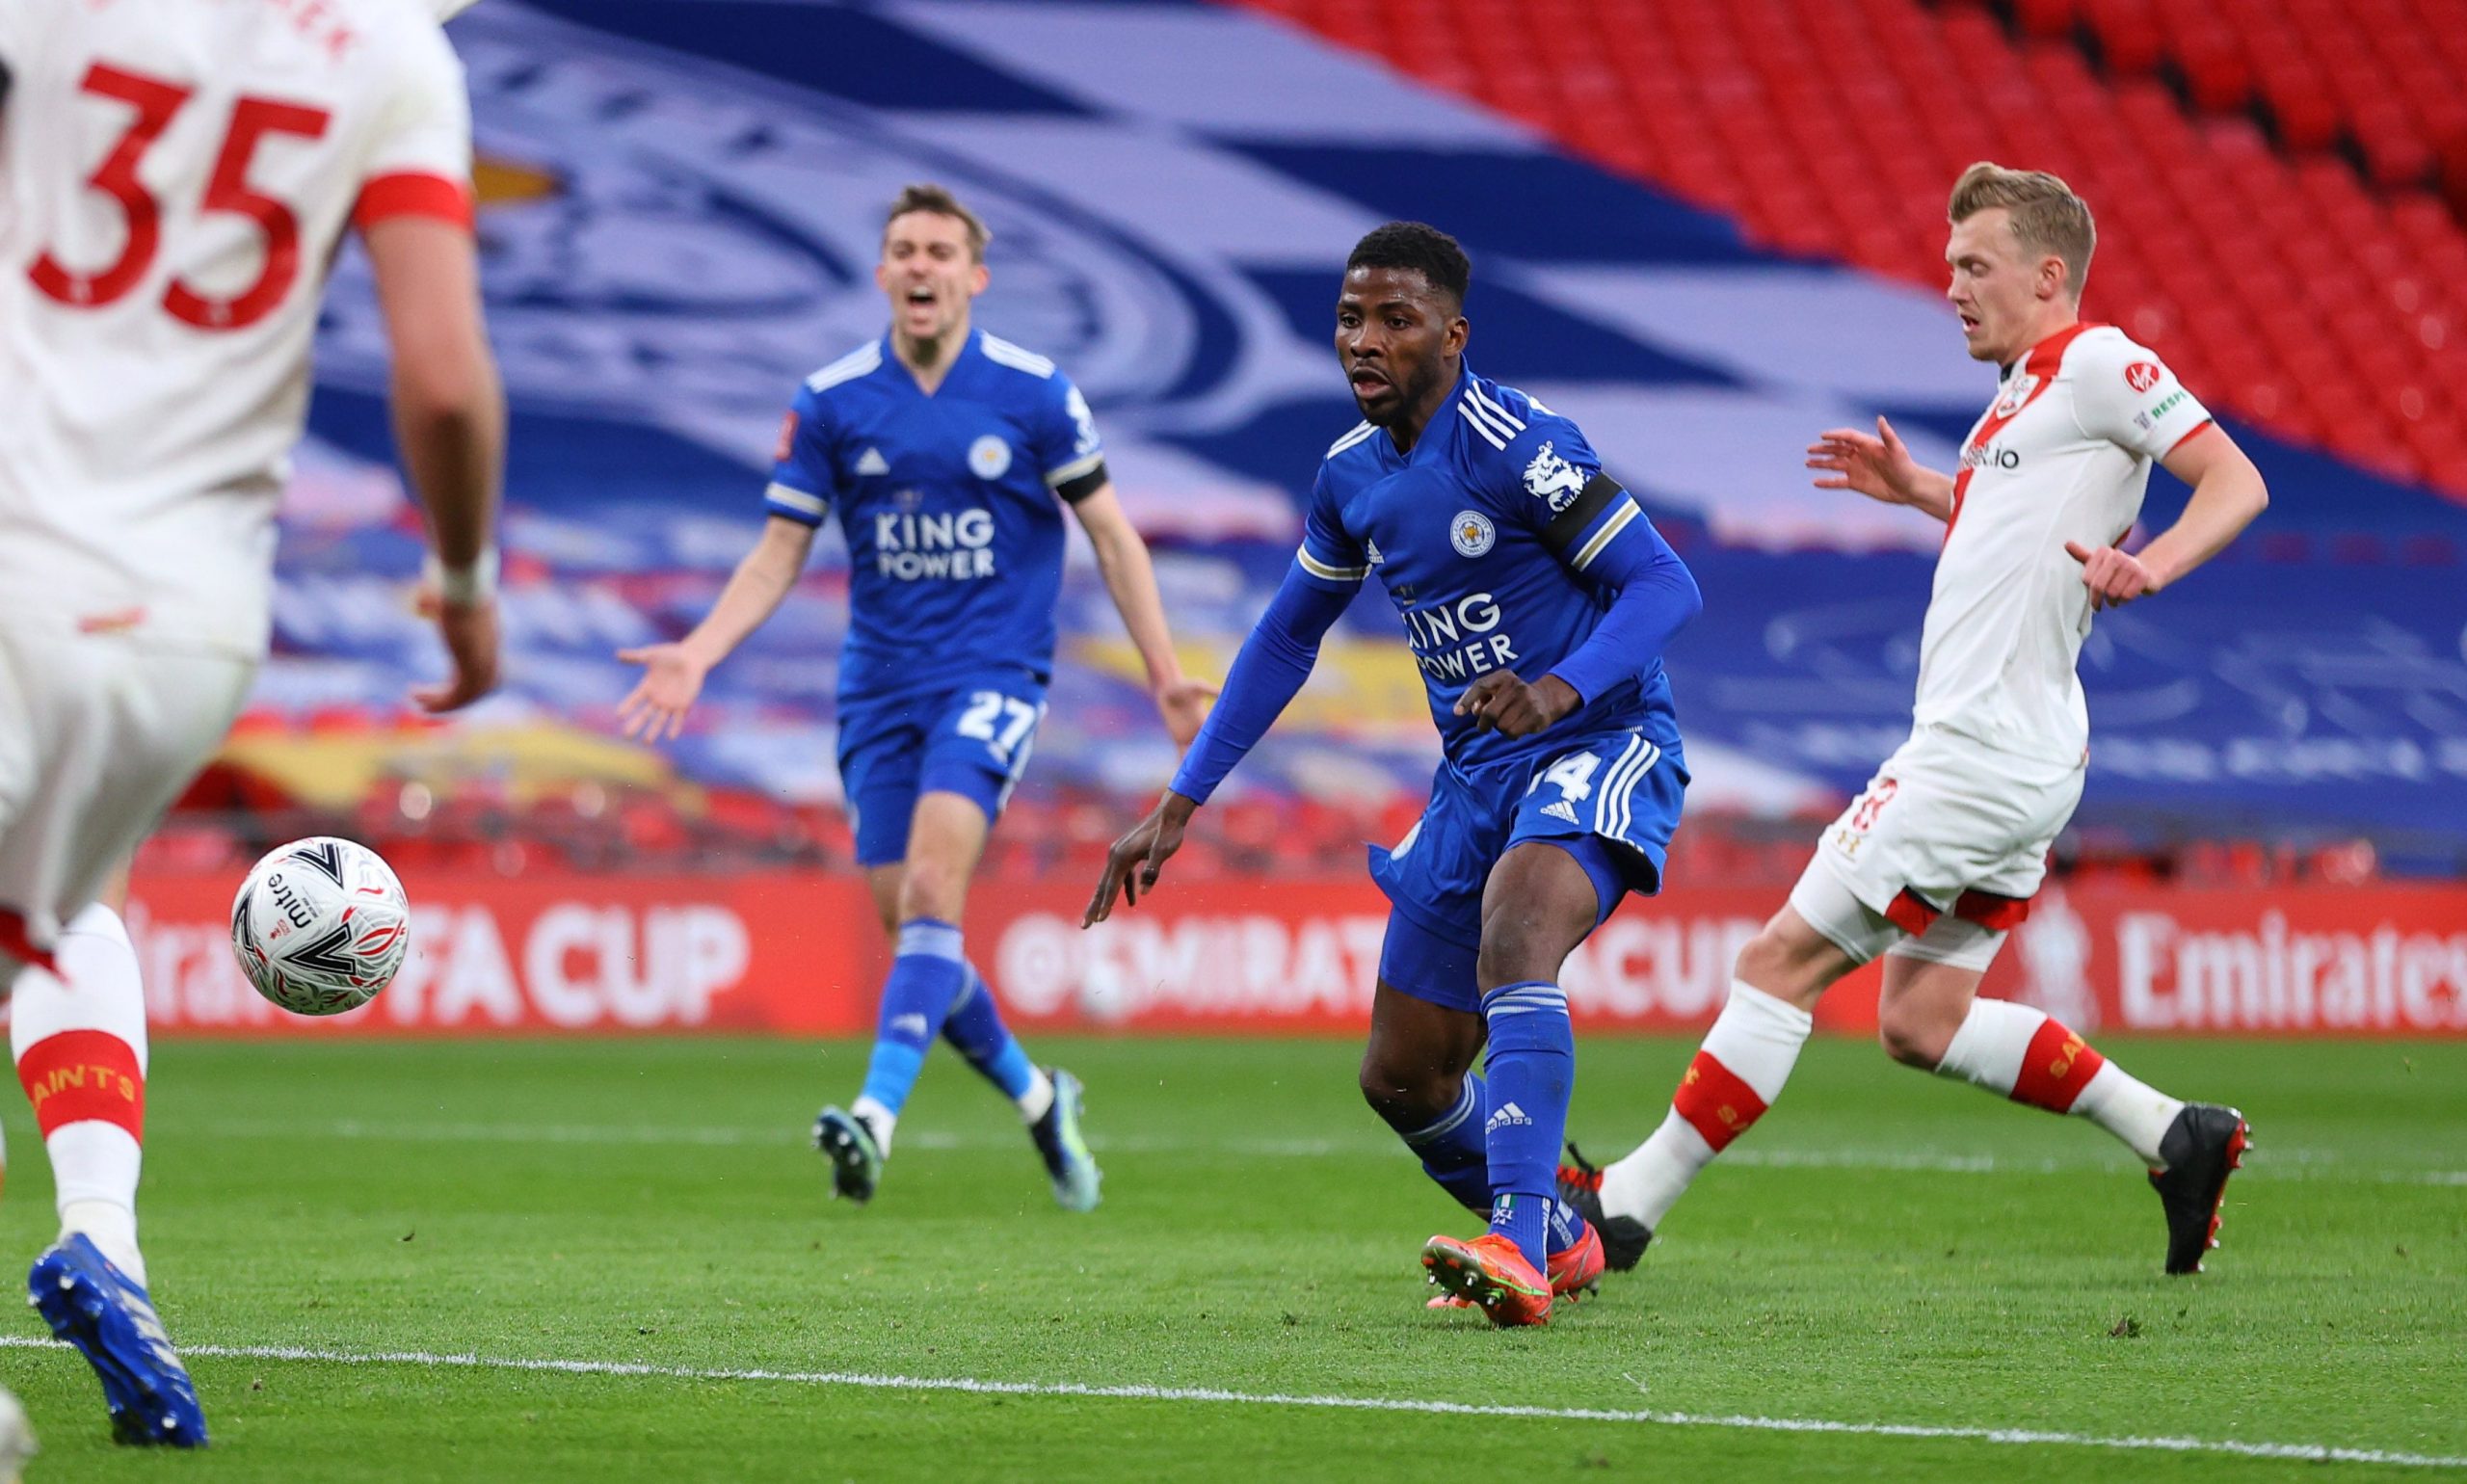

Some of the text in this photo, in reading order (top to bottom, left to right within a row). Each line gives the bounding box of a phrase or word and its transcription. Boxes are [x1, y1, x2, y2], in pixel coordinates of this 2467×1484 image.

[25, 60, 332, 333] 35
[874, 508, 995, 550] KING
[878, 546, 995, 580] POWER
[956, 690, 1035, 764] 27
[268, 872, 312, 929] mitre
[387, 903, 526, 1027] FA
[522, 902, 752, 1027] CUP
[33, 1063, 135, 1110] AINTS
[1485, 1115, 1533, 1135] adidas
